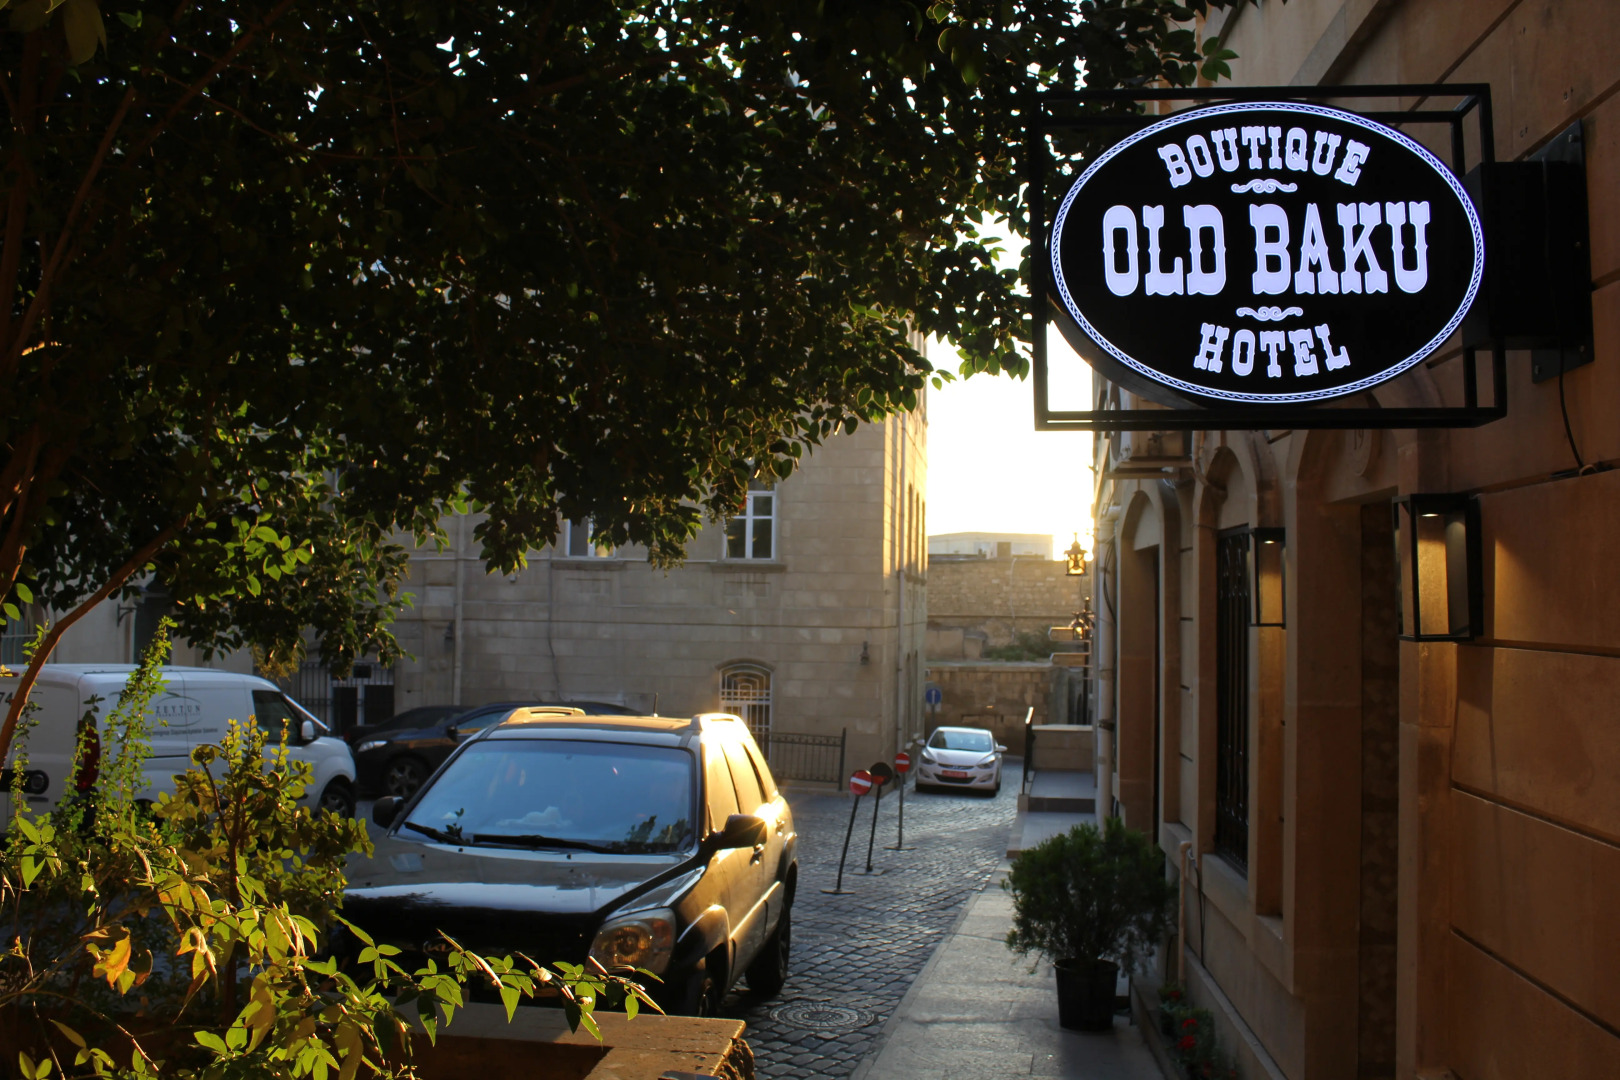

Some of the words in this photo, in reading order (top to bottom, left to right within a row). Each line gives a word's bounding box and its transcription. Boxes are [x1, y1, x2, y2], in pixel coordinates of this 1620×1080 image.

[1158, 126, 1370, 188] BOUTIQUE
[1103, 204, 1227, 296] OLD
[1249, 201, 1431, 295] BAKU
[1194, 322, 1350, 378] HOTEL
[156, 704, 201, 713] ZEYTUN
